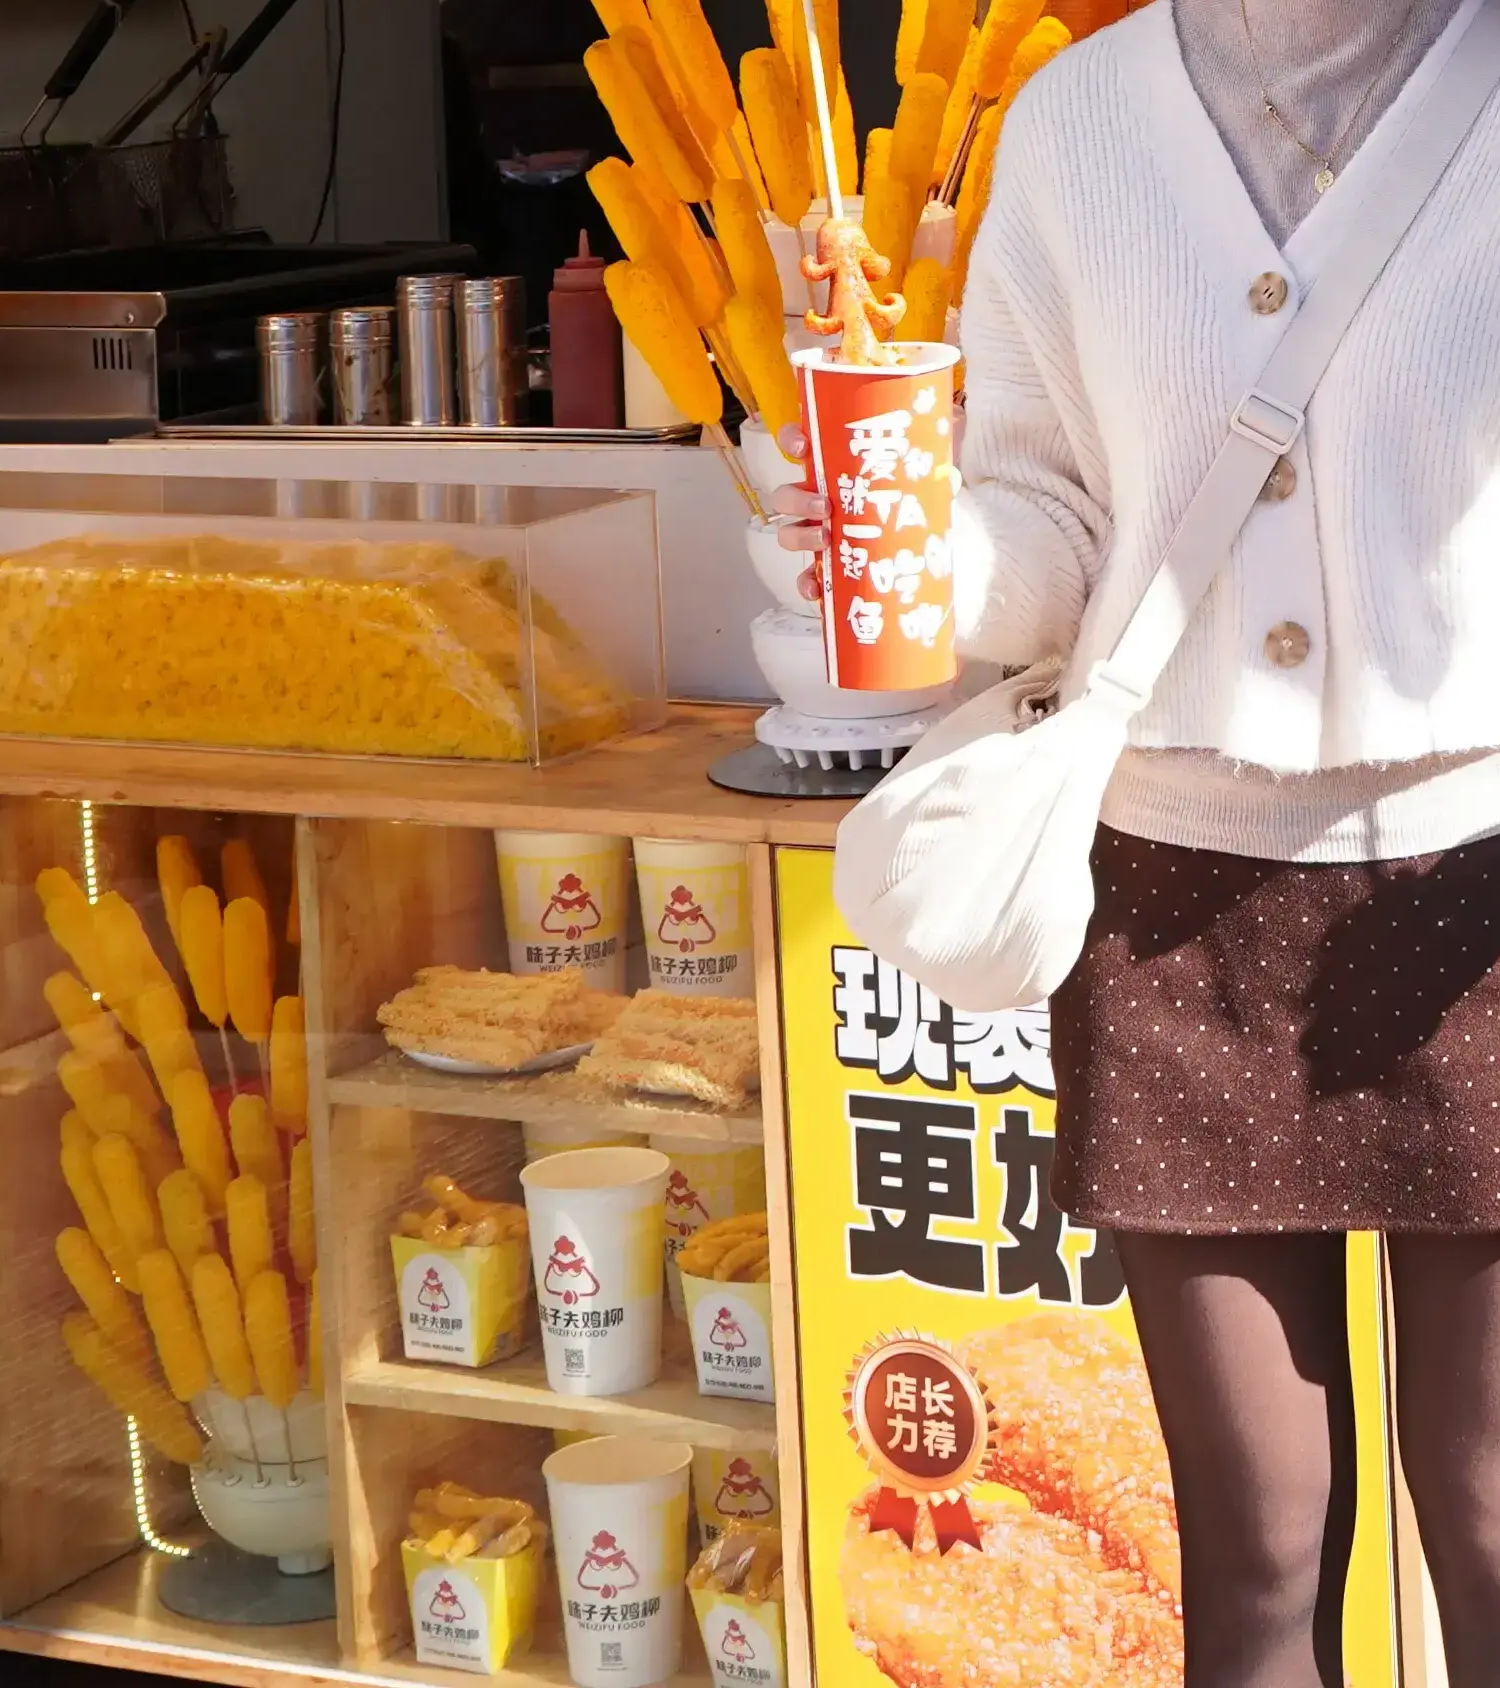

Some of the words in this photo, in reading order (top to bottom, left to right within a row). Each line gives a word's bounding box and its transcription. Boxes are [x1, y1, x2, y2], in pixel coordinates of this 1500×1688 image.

[885, 1371, 955, 1417] 店长
[887, 1415, 959, 1461] 力荐
[568, 1595, 661, 1623] 味子夫鸡柳
[617, 1619, 646, 1631] FOOD
